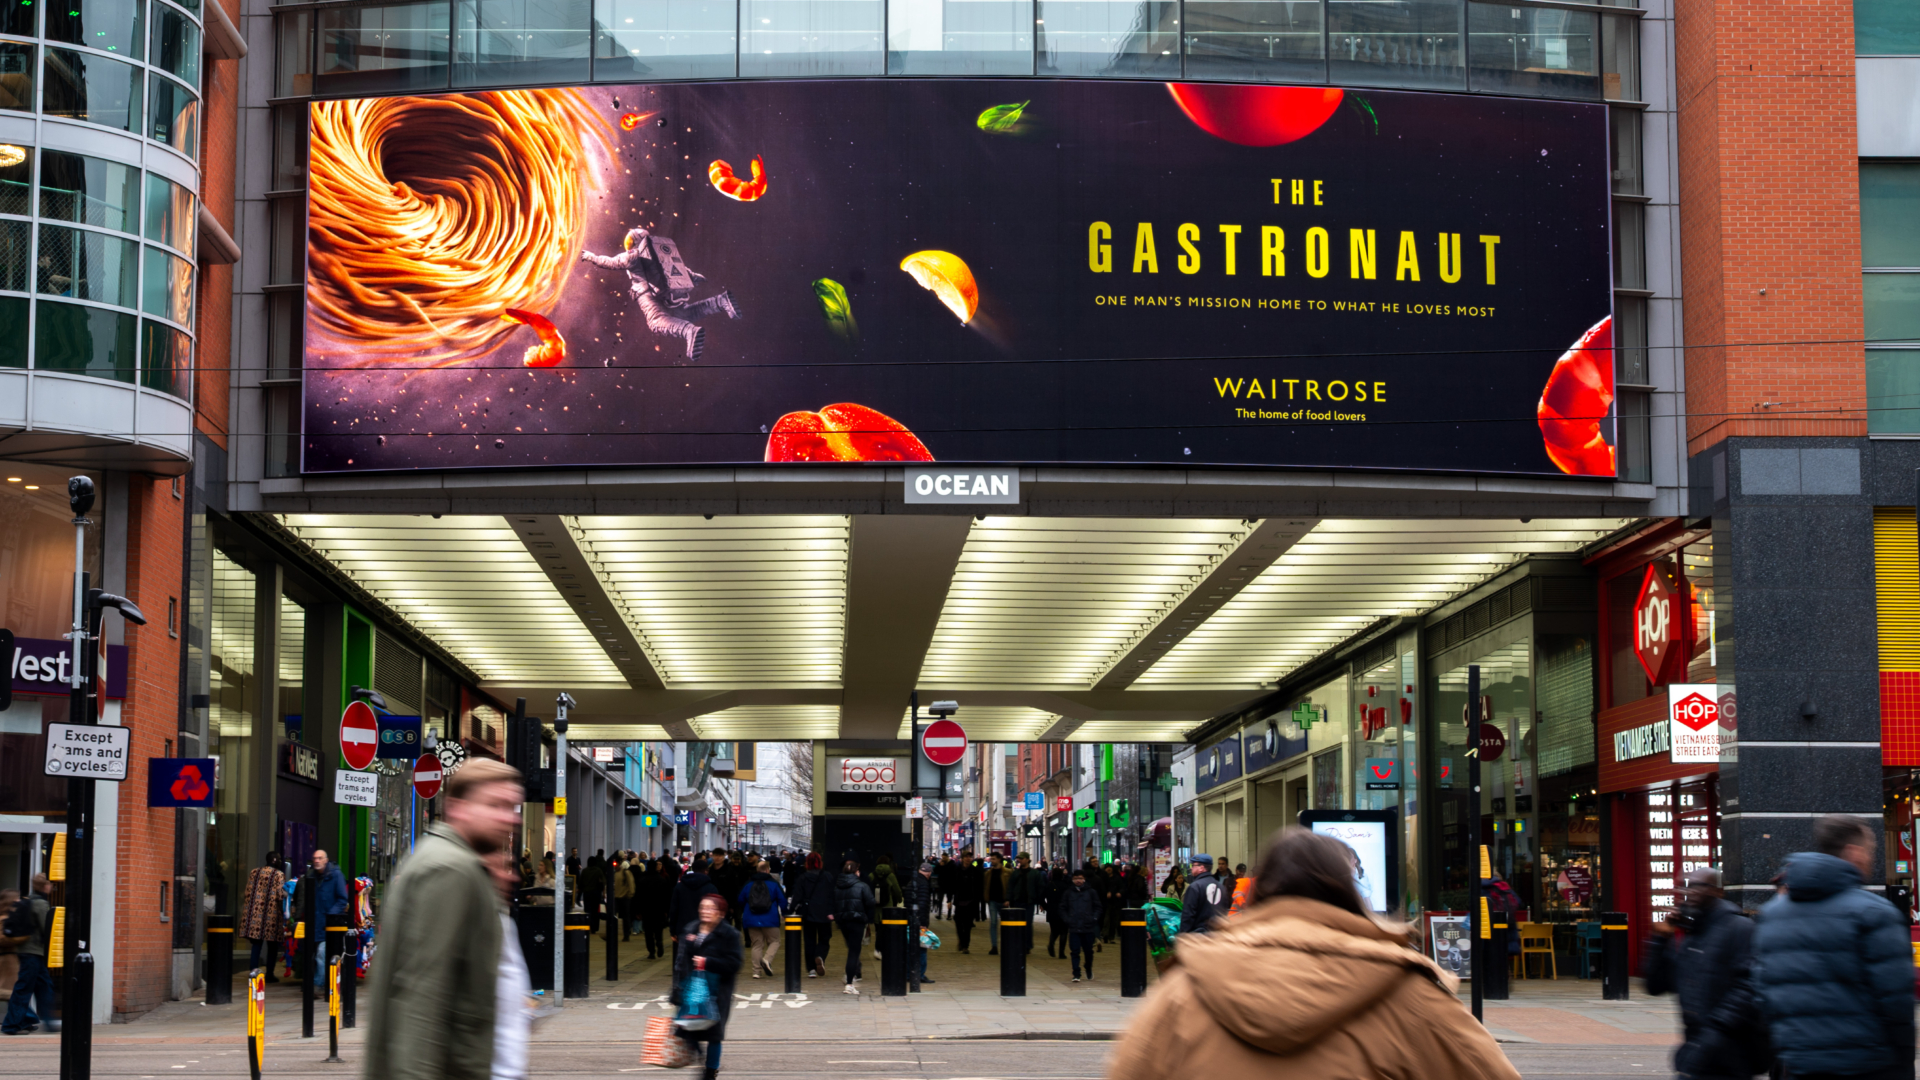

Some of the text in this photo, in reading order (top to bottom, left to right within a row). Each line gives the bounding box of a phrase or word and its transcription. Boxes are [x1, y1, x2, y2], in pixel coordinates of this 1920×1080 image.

[1271, 179, 1323, 206] THE
[1088, 220, 1500, 286] GASTRONAUT
[1095, 295, 1496, 317] ONE MAN'S MISSION HOME TO WHAT HE LOVES MOST
[1214, 377, 1387, 403] WAITROSE
[1235, 408, 1367, 422] The home of food lovers
[915, 474, 1009, 495] OCEAN
[65, 730, 113, 744] Except
[383, 731, 415, 742] TSB
[1480, 738, 1502, 746] OSTA
[1614, 720, 1669, 762] VIETNAMESE STRE
[1675, 735, 1719, 744] VIETNAMESE
[52, 743, 122, 758] ams and
[445, 741, 465, 755] SHEEP
[1676, 746, 1719, 756] STREET EATS
[64, 761, 108, 772] cycles
[296, 746, 318, 780] NatWest
[443, 762, 463, 775] OFFEE
[842, 759, 896, 783] food
[345, 773, 369, 784] Except
[338, 783, 359, 792] trams
[344, 793, 367, 802] cycles
[1442, 931, 1460, 939] COFFEE
